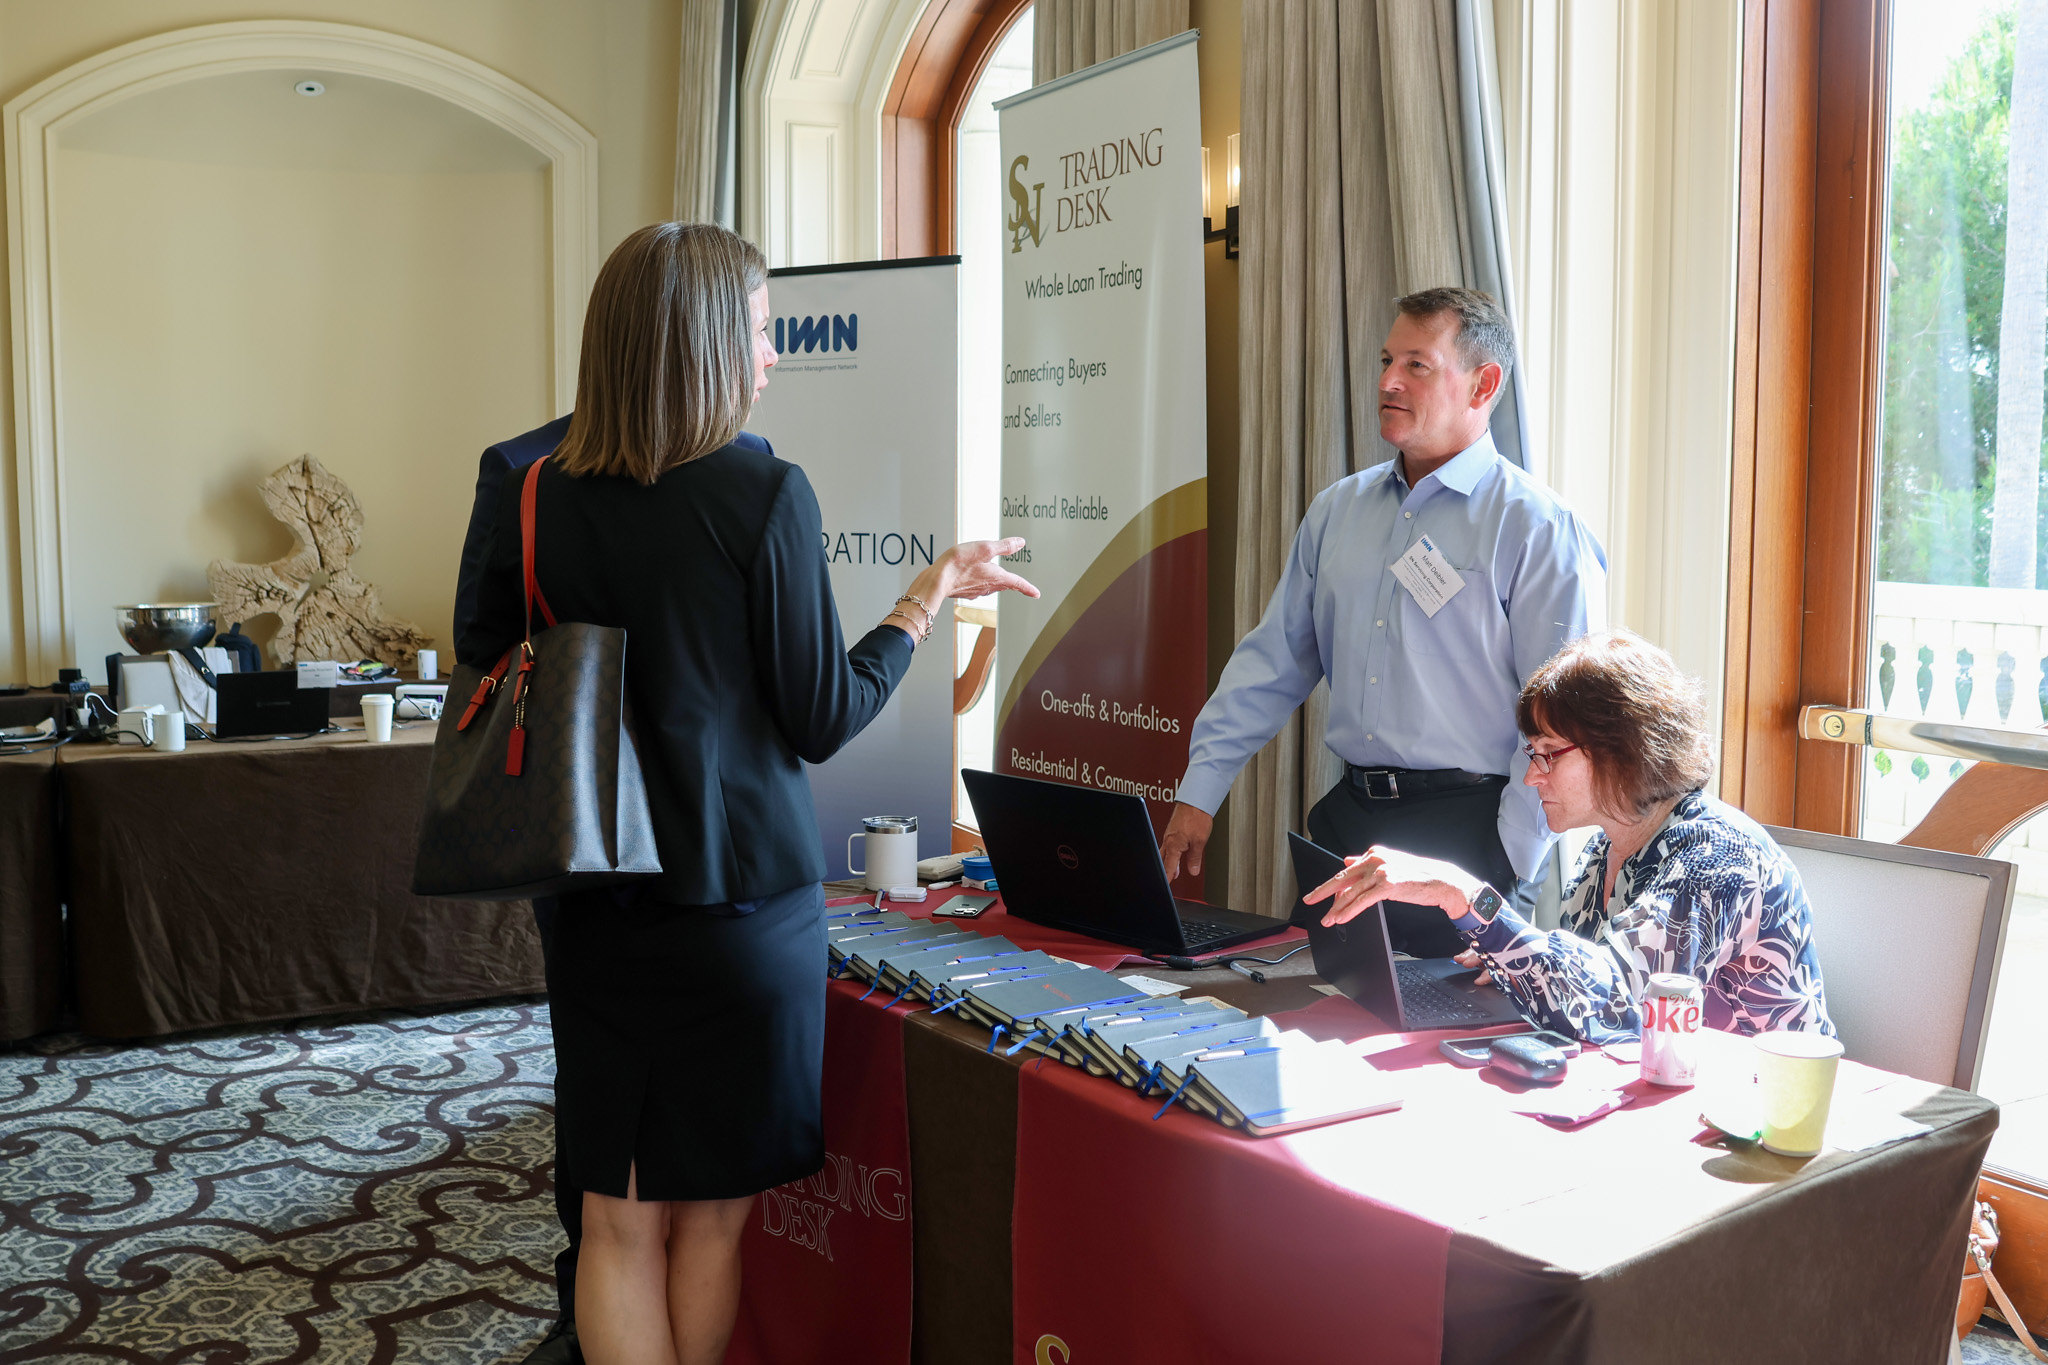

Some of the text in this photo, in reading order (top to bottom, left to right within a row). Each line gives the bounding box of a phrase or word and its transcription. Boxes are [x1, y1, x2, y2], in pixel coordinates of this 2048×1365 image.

[1060, 128, 1164, 190] TRADING
[1056, 186, 1113, 233] DESK
[1025, 260, 1143, 300] Whole Loan Trading
[775, 313, 858, 355] IMN
[804, 365, 837, 373] Management
[837, 363, 858, 371] Network
[1004, 358, 1107, 387] Connecting Buyers
[1004, 403, 1062, 429] and Sellers
[1002, 494, 1109, 521] Quick and Reliable
[1001, 544, 1032, 563] esults
[1041, 689, 1181, 735] One-offs & Portfolios
[1011, 747, 1180, 803] Residential & Commercial
[1668, 993, 1696, 1006] Diet
[762, 1188, 834, 1262] DESK
